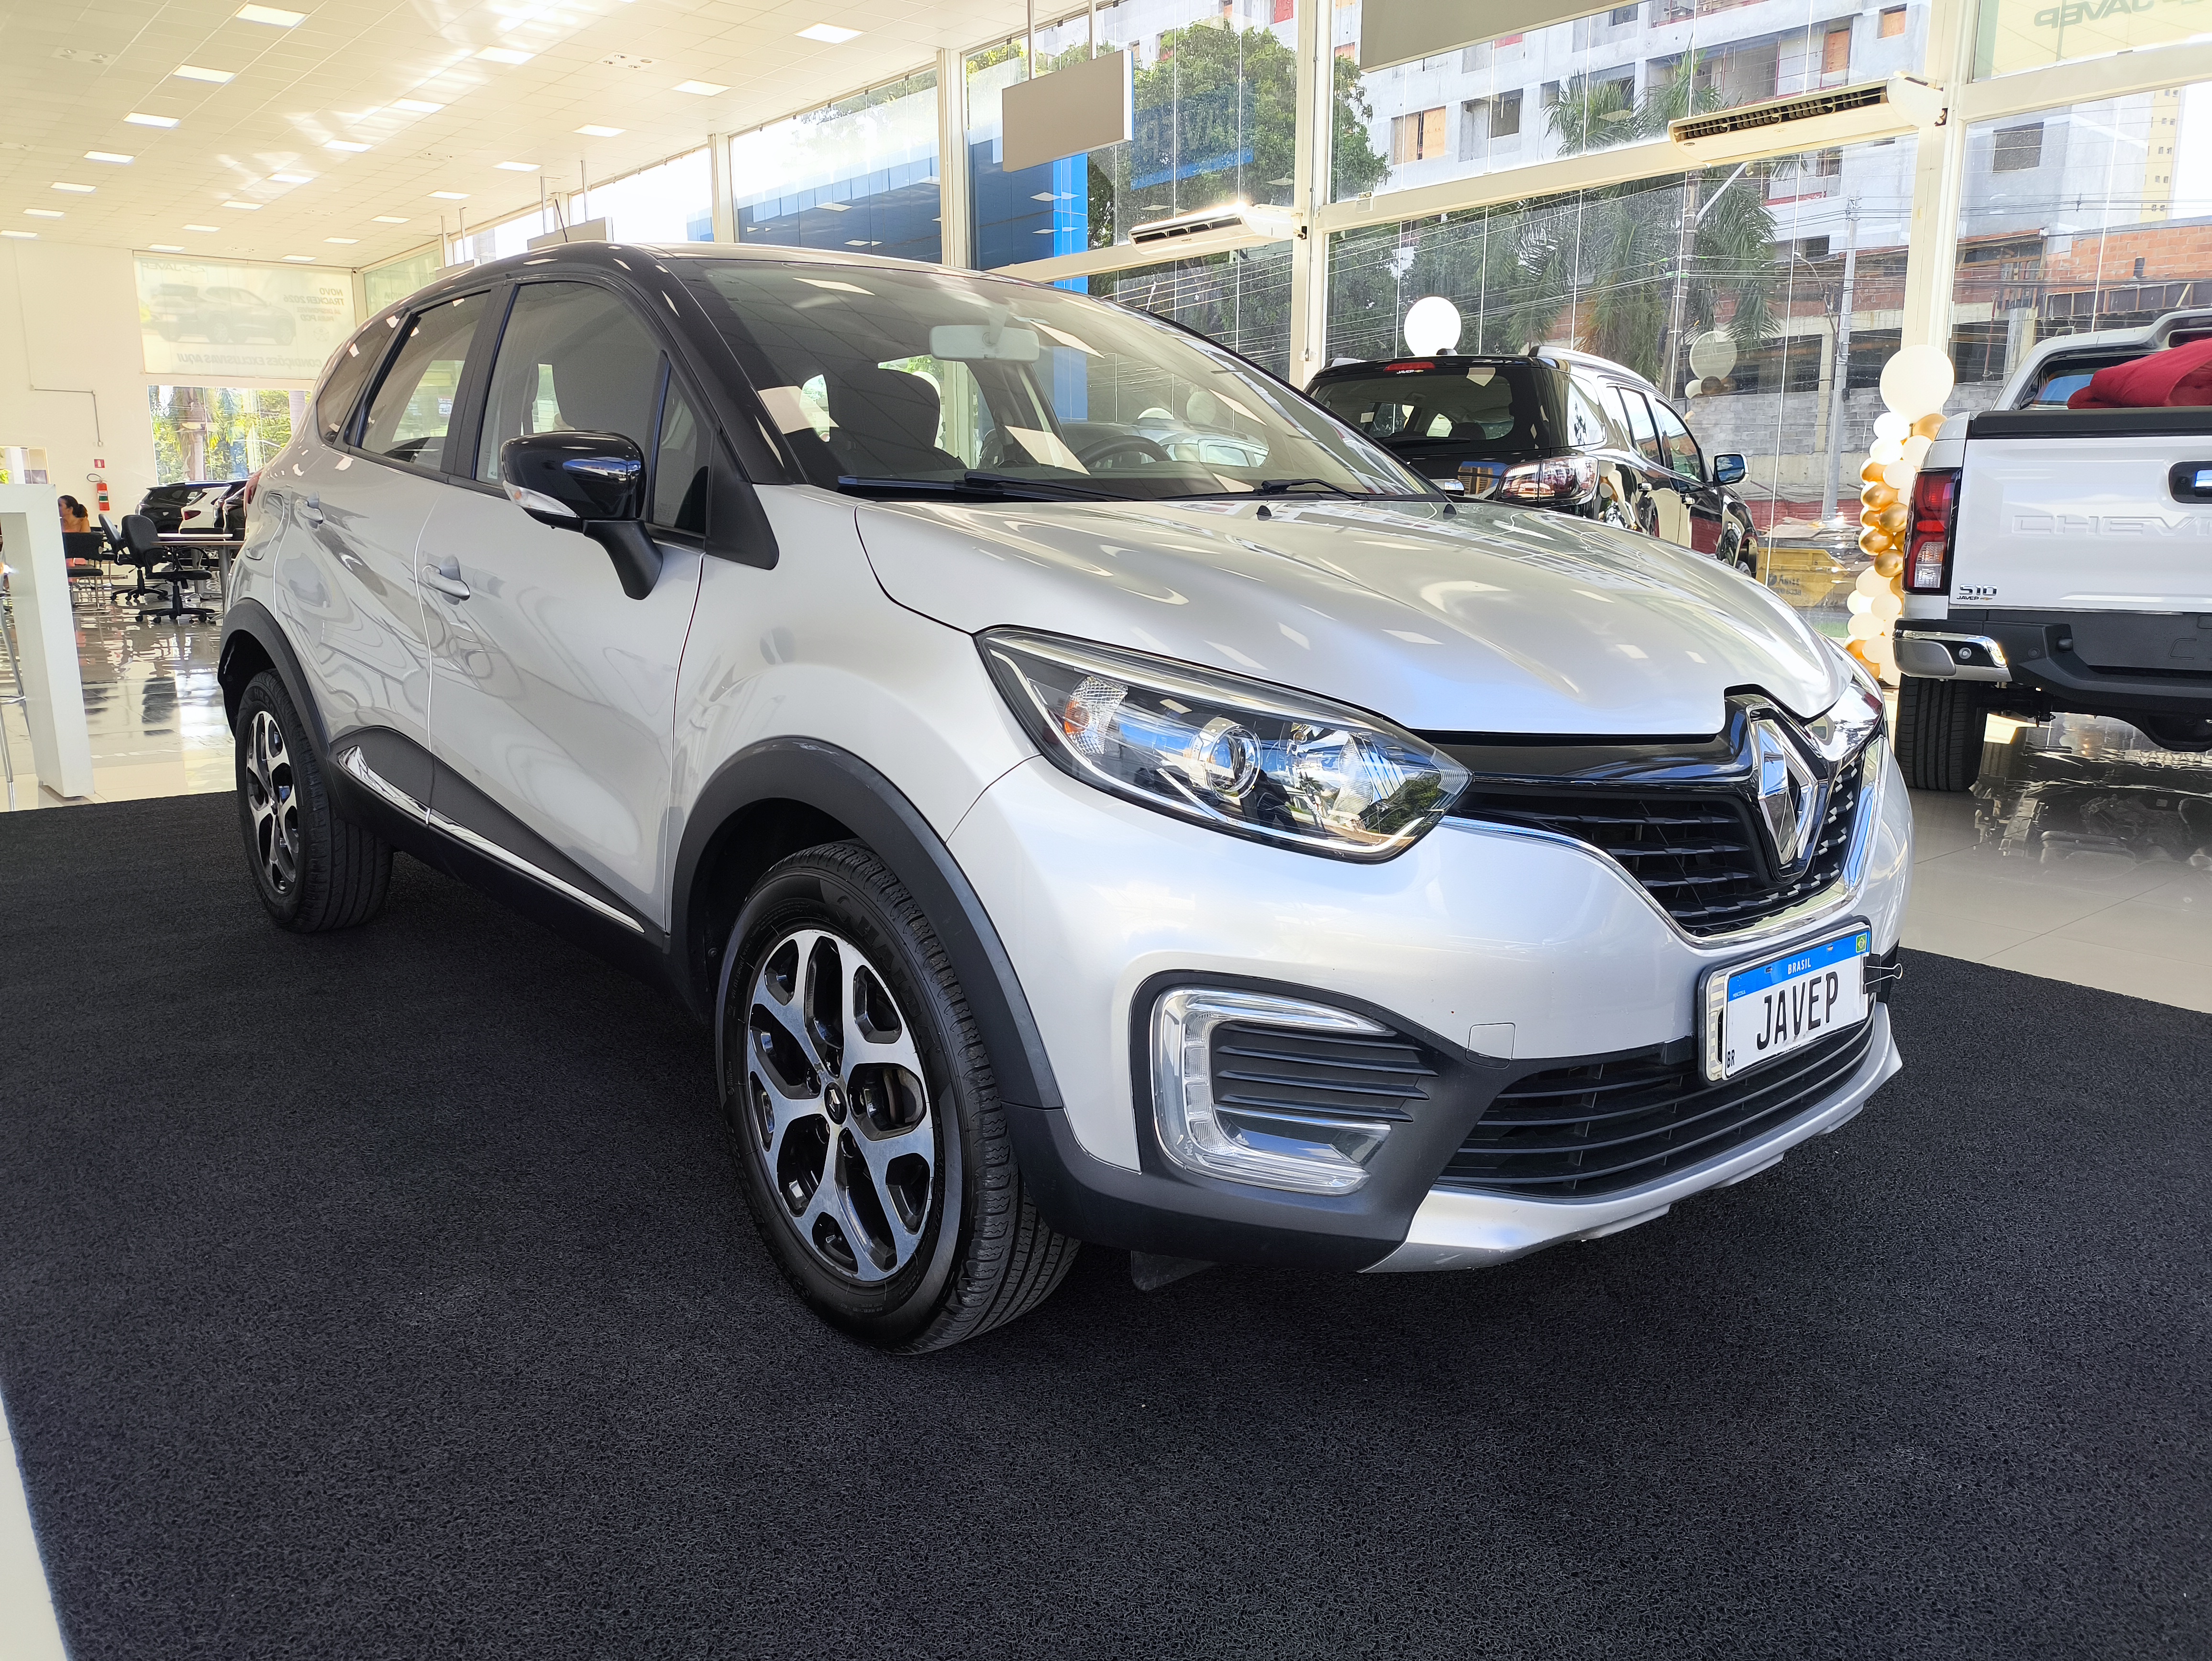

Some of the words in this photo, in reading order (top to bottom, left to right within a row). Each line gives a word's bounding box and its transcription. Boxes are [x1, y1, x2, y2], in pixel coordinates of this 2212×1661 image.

[1959, 583, 1998, 596] S10
[1788, 957, 1812, 975] BRASIL
[1756, 971, 1839, 1051] JAVEP
[1727, 1049, 1736, 1068] BR
